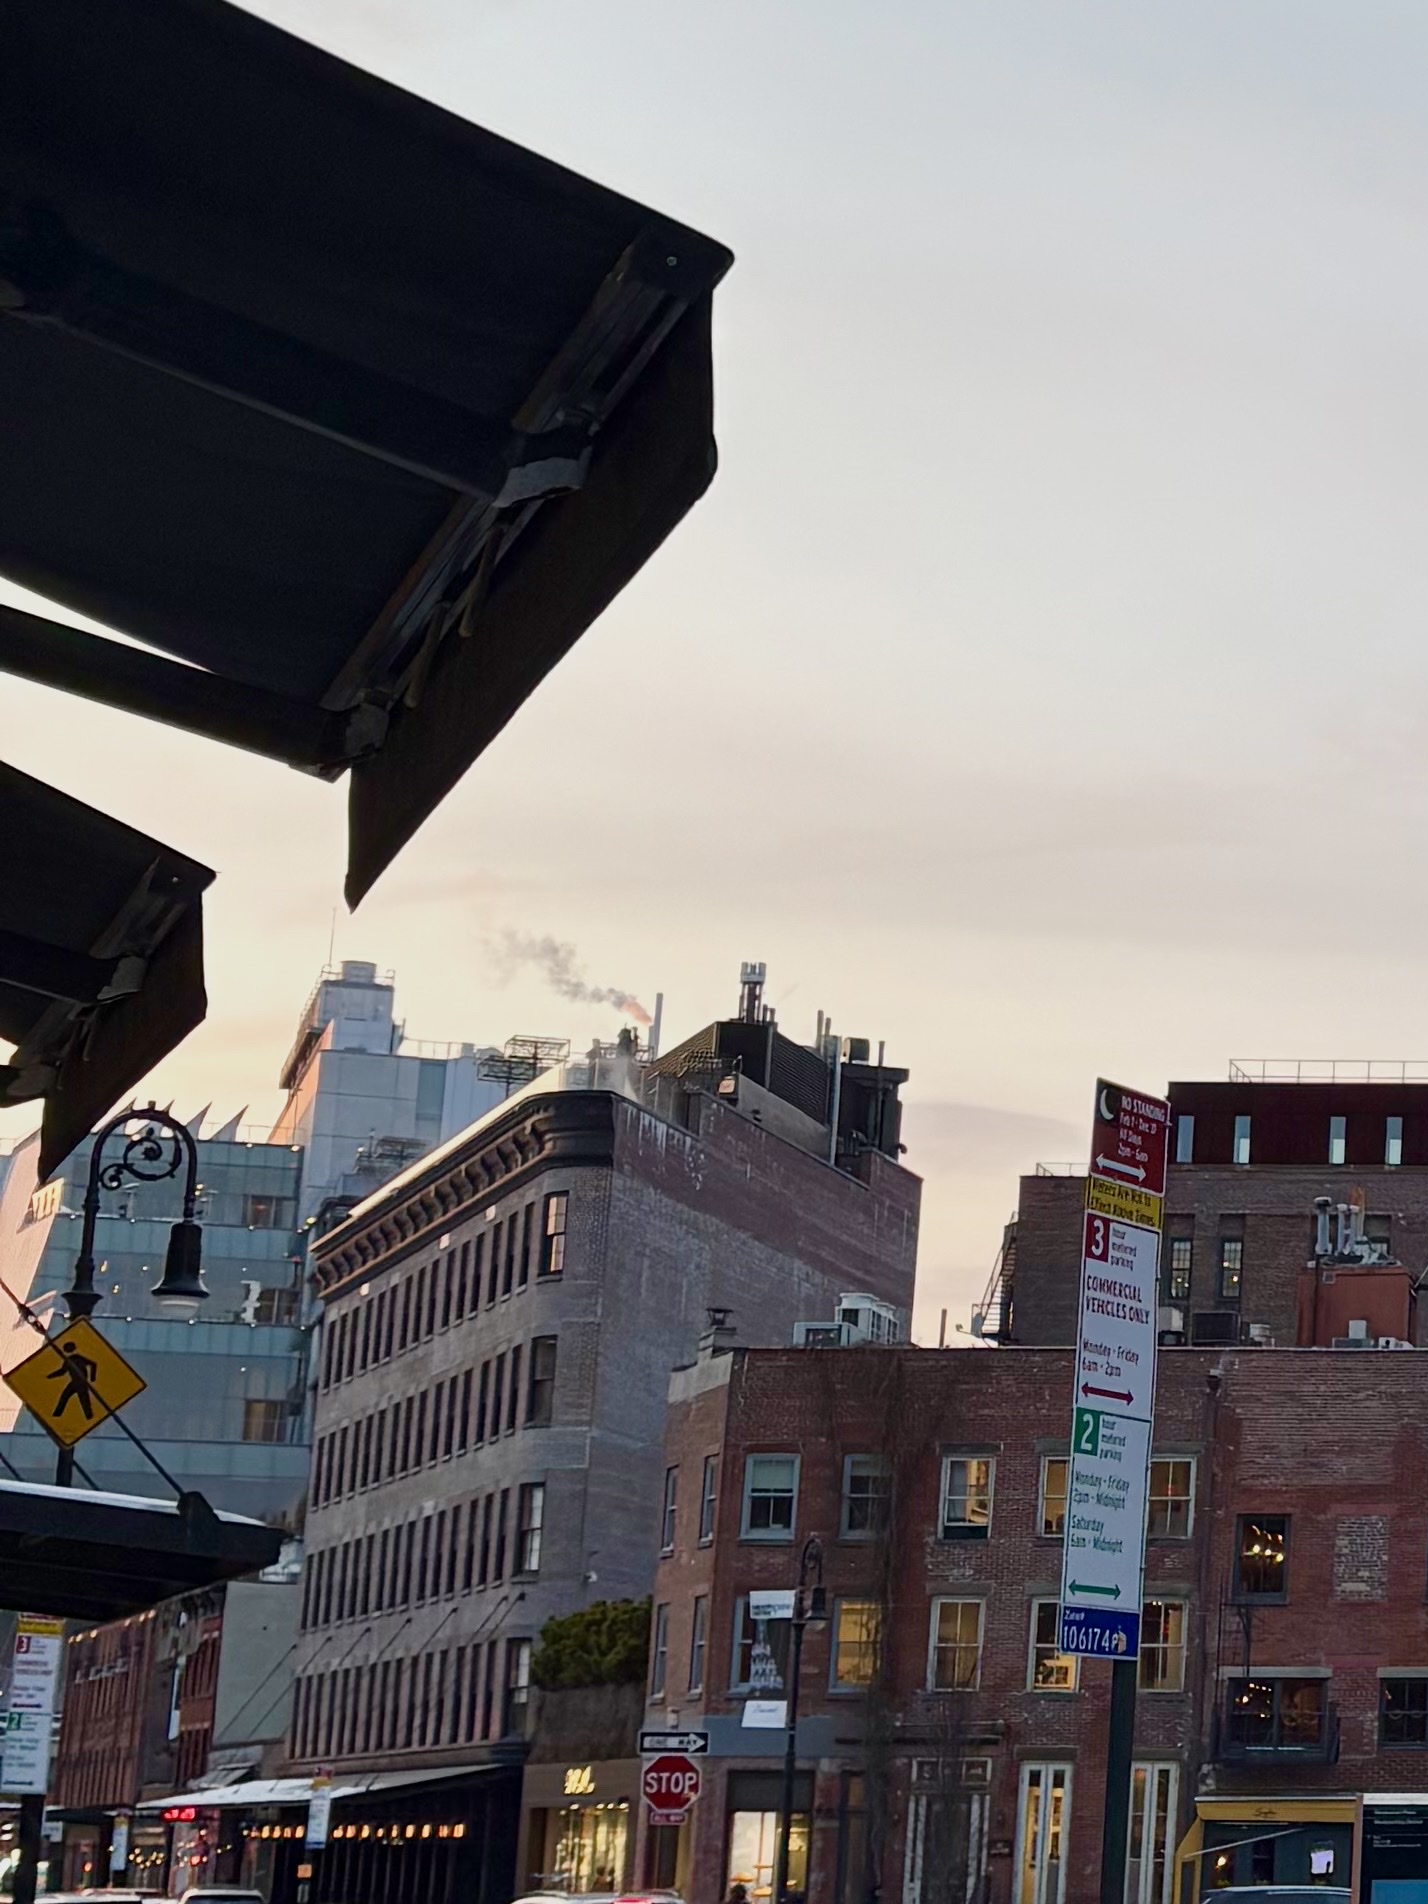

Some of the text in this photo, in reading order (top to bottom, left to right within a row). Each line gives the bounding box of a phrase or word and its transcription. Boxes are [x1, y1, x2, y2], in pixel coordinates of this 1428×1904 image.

[1091, 1219, 1104, 1256] 3
[1086, 1275, 1142, 1303] COMMERCIAL
[1086, 1295, 1150, 1325] VEHICLES ONLY
[1083, 1338, 1111, 1360] Monday
[1117, 1345, 1139, 1365] Friday
[1080, 1413, 1094, 1451] 2
[1108, 1475, 1130, 1495] Friday
[1071, 1514, 1104, 1536] Saturday
[1063, 1625, 1110, 1652] 106174
[645, 1772, 697, 1794] STOP
